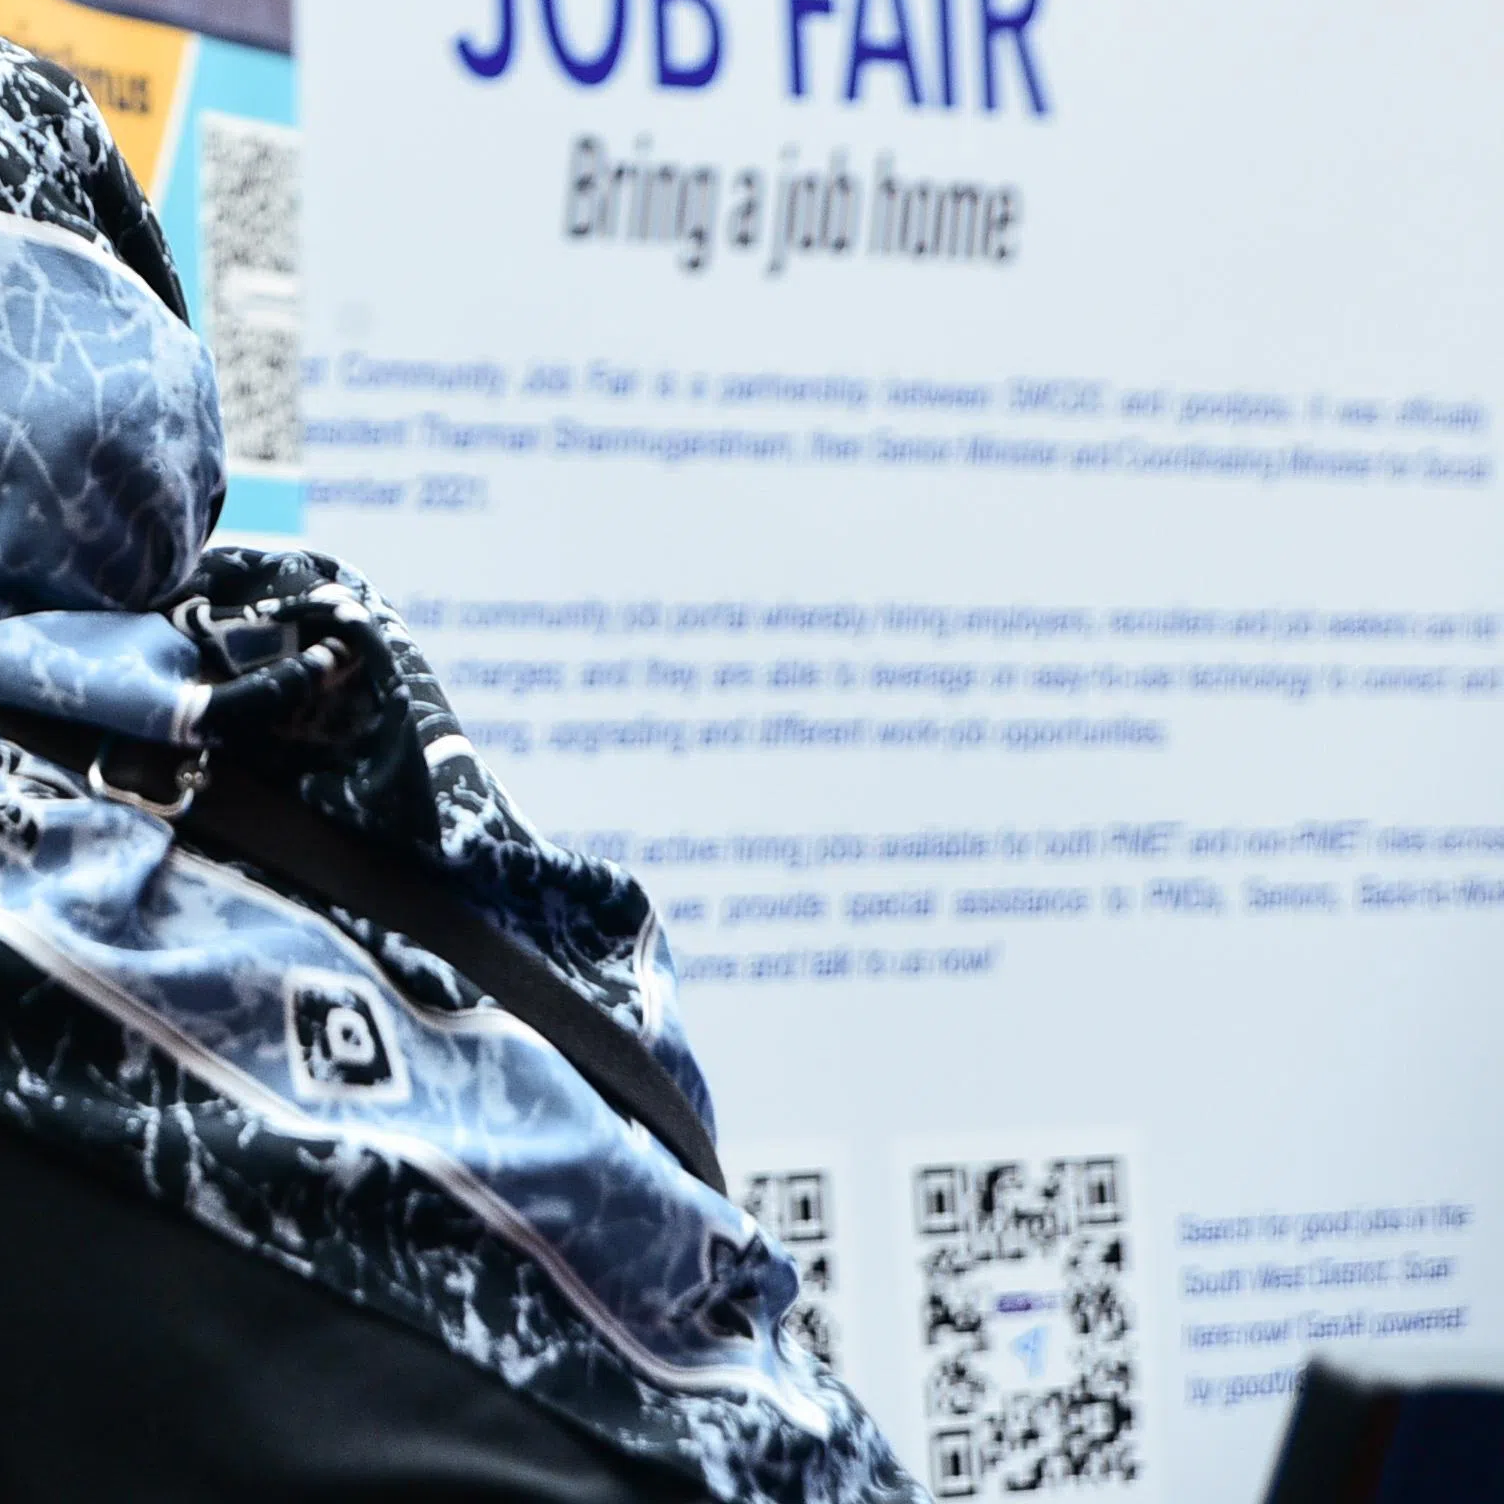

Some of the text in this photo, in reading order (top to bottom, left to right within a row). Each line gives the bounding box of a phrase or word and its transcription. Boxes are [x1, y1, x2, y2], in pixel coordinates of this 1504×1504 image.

[563, 133, 1022, 278] Bring a job home
